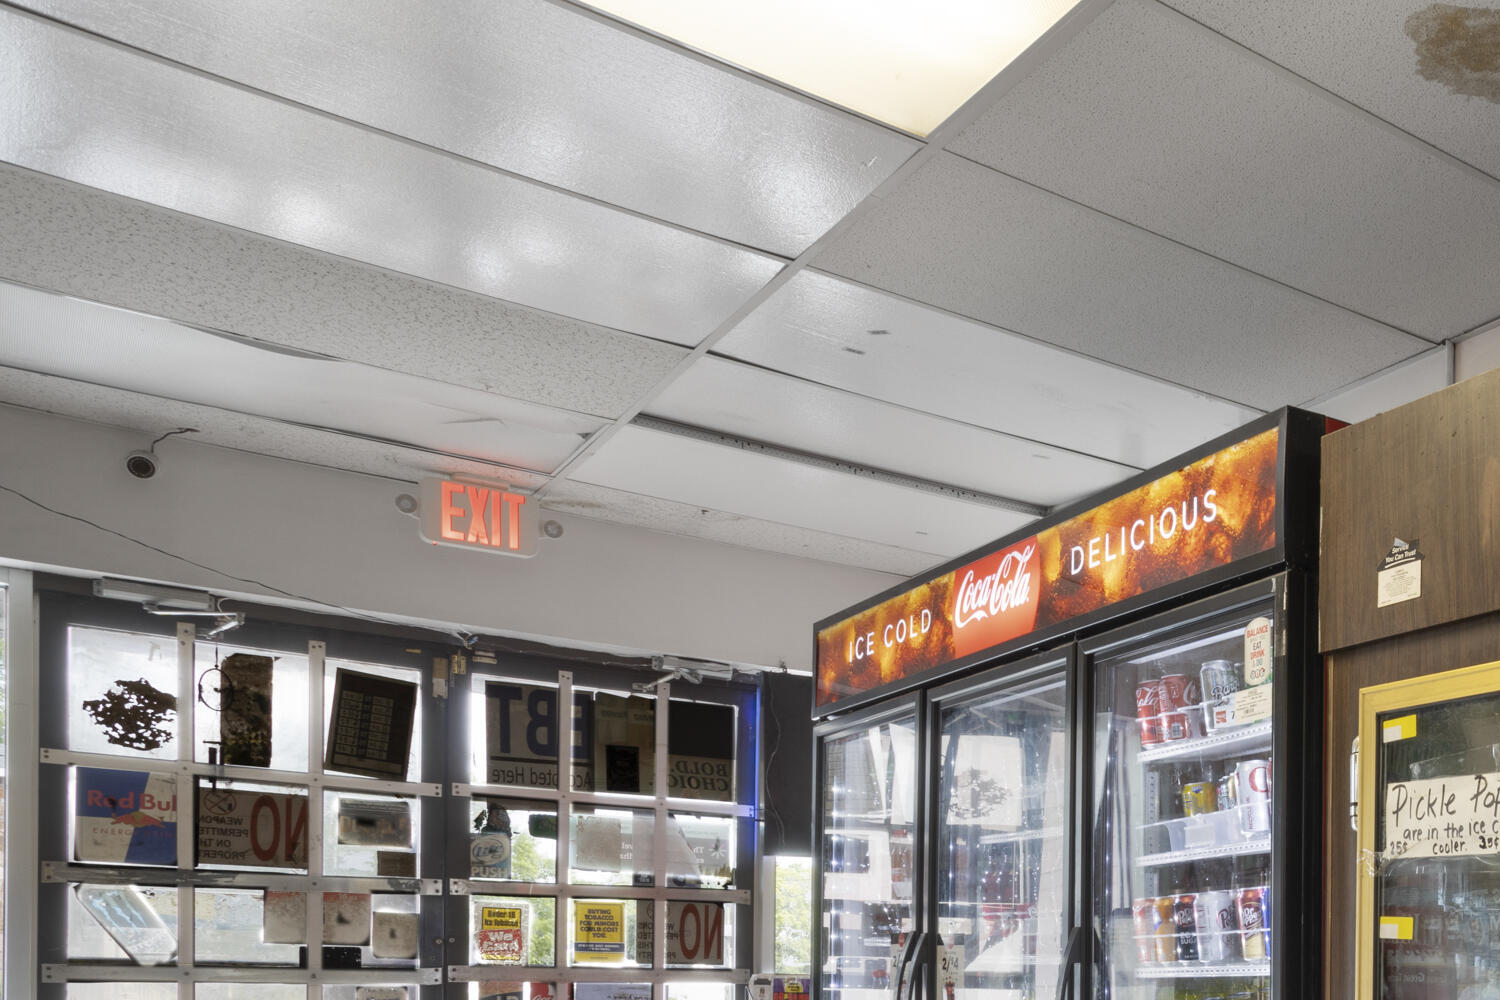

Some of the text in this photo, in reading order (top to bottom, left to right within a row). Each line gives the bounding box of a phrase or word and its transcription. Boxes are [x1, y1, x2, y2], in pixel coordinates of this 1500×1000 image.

[441, 481, 526, 550] EXIT
[1071, 488, 1218, 575] DELICIOUS
[955, 543, 1036, 628] Coca-Cola
[848, 608, 932, 663] ICE COLD
[1246, 624, 1269, 638] BALANCE
[1253, 642, 1262, 650] EAT
[87, 789, 178, 812] Red Bul
[1392, 784, 1457, 827] Pickle
[1403, 829, 1423, 841] are
[1427, 826, 1439, 840] in
[1444, 822, 1464, 838] the
[1468, 820, 1486, 836] ice
[471, 866, 509, 878] PUSH
